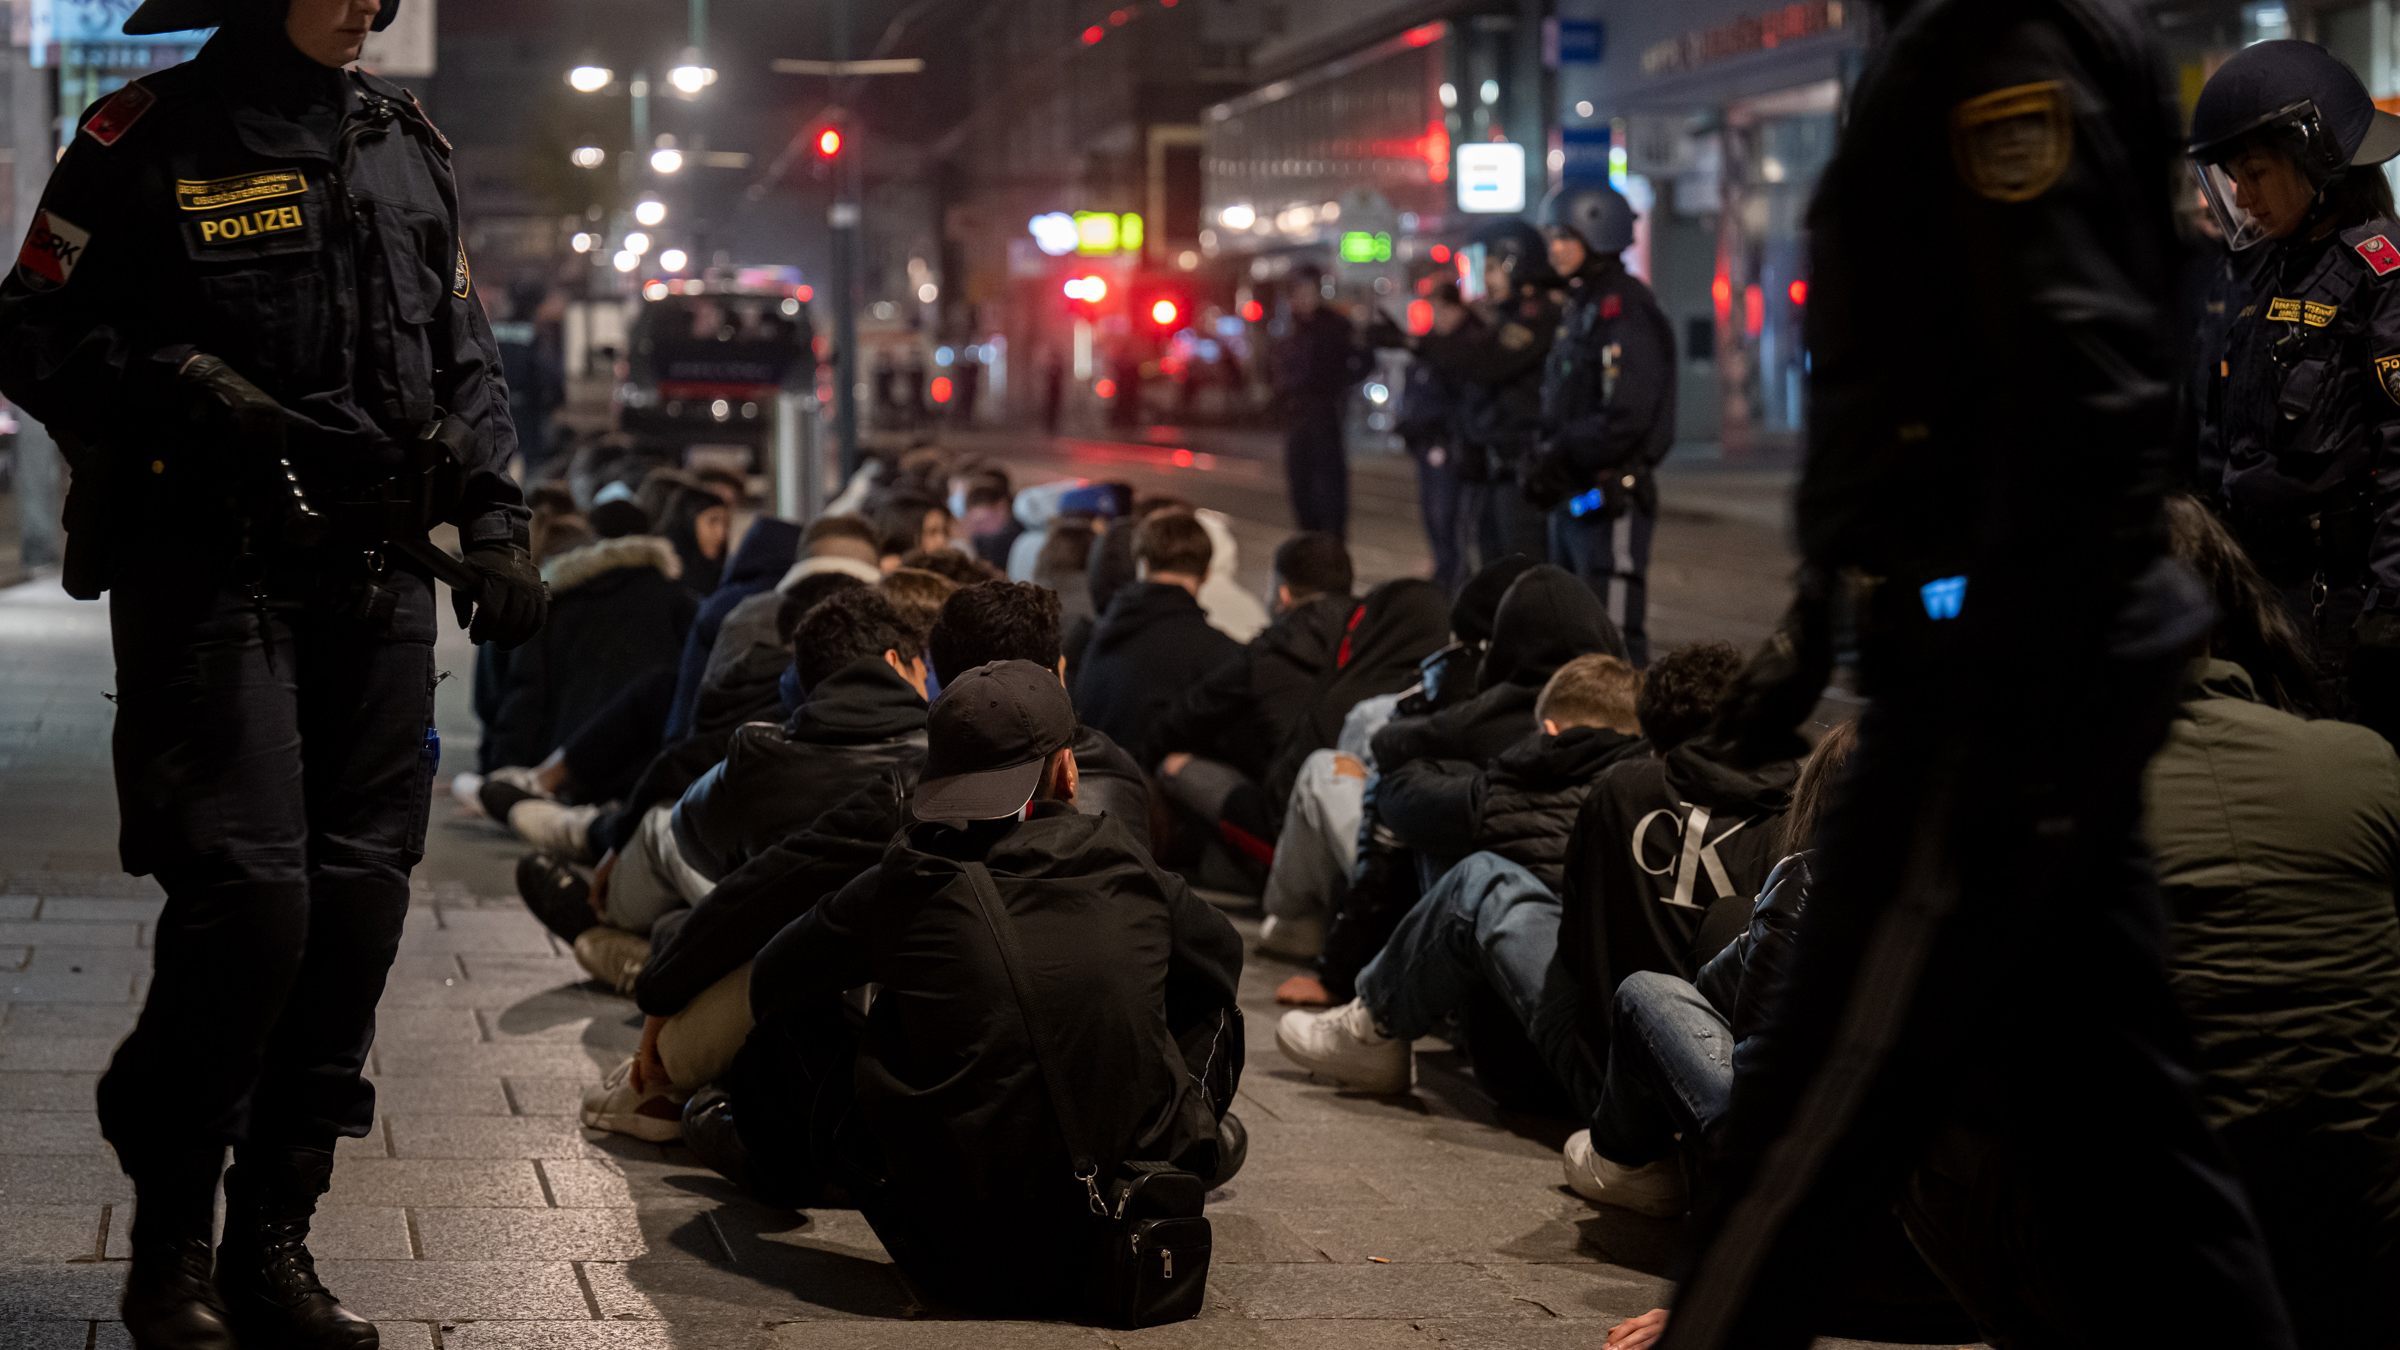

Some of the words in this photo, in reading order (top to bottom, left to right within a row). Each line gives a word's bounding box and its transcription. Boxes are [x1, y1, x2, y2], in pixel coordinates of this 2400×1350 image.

[200, 205, 303, 242] POLIZEI
[29, 228, 81, 267] SRK
[1632, 801, 1758, 910] CK
